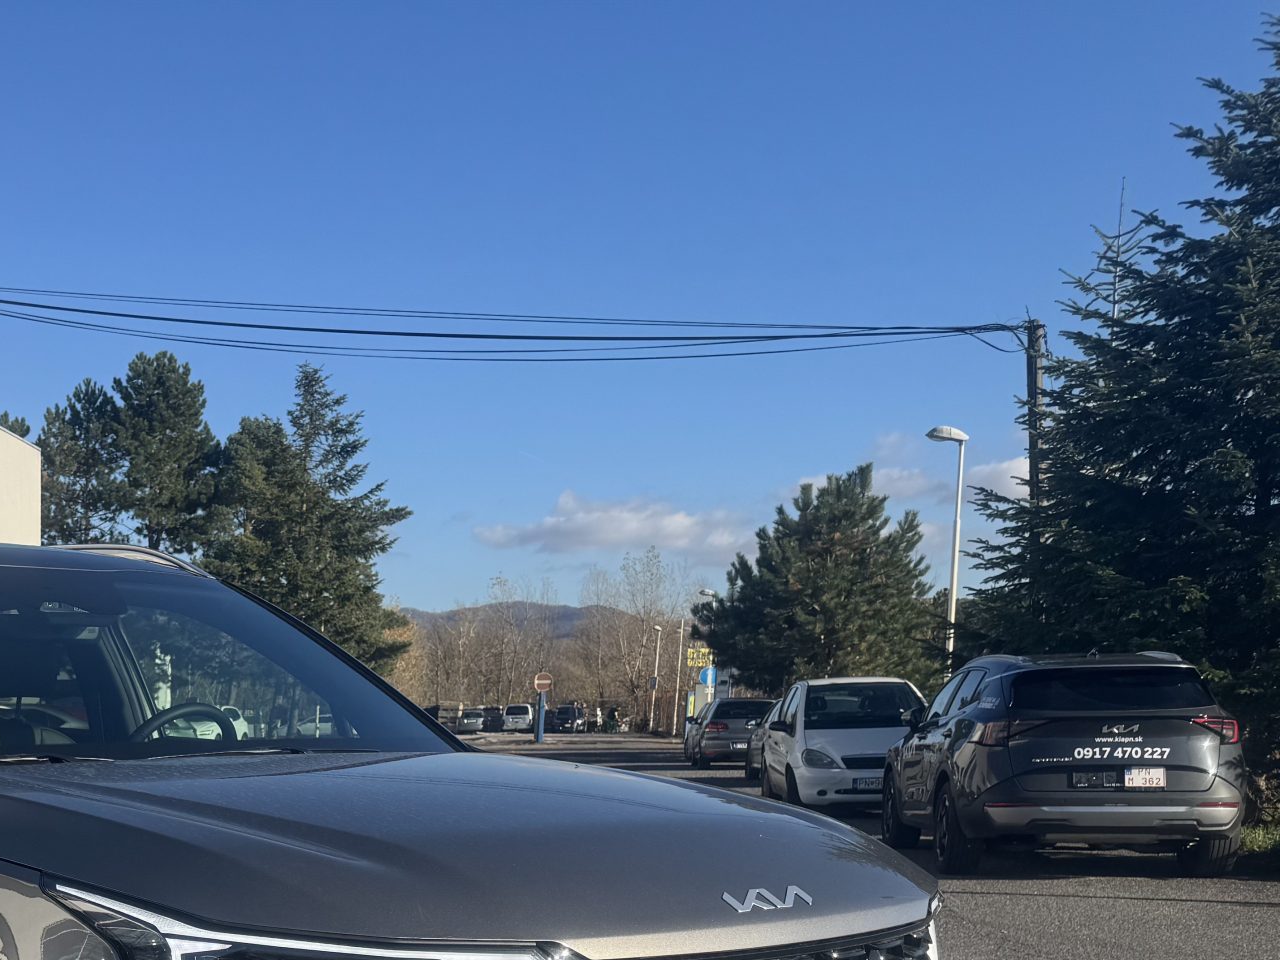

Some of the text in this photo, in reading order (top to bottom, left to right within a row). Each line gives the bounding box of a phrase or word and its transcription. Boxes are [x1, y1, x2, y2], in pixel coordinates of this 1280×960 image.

[1094, 735, 1143, 743] www.kiapn.sk
[1074, 747, 1171, 759] 0917 470 227
[721, 885, 813, 913] KIA
